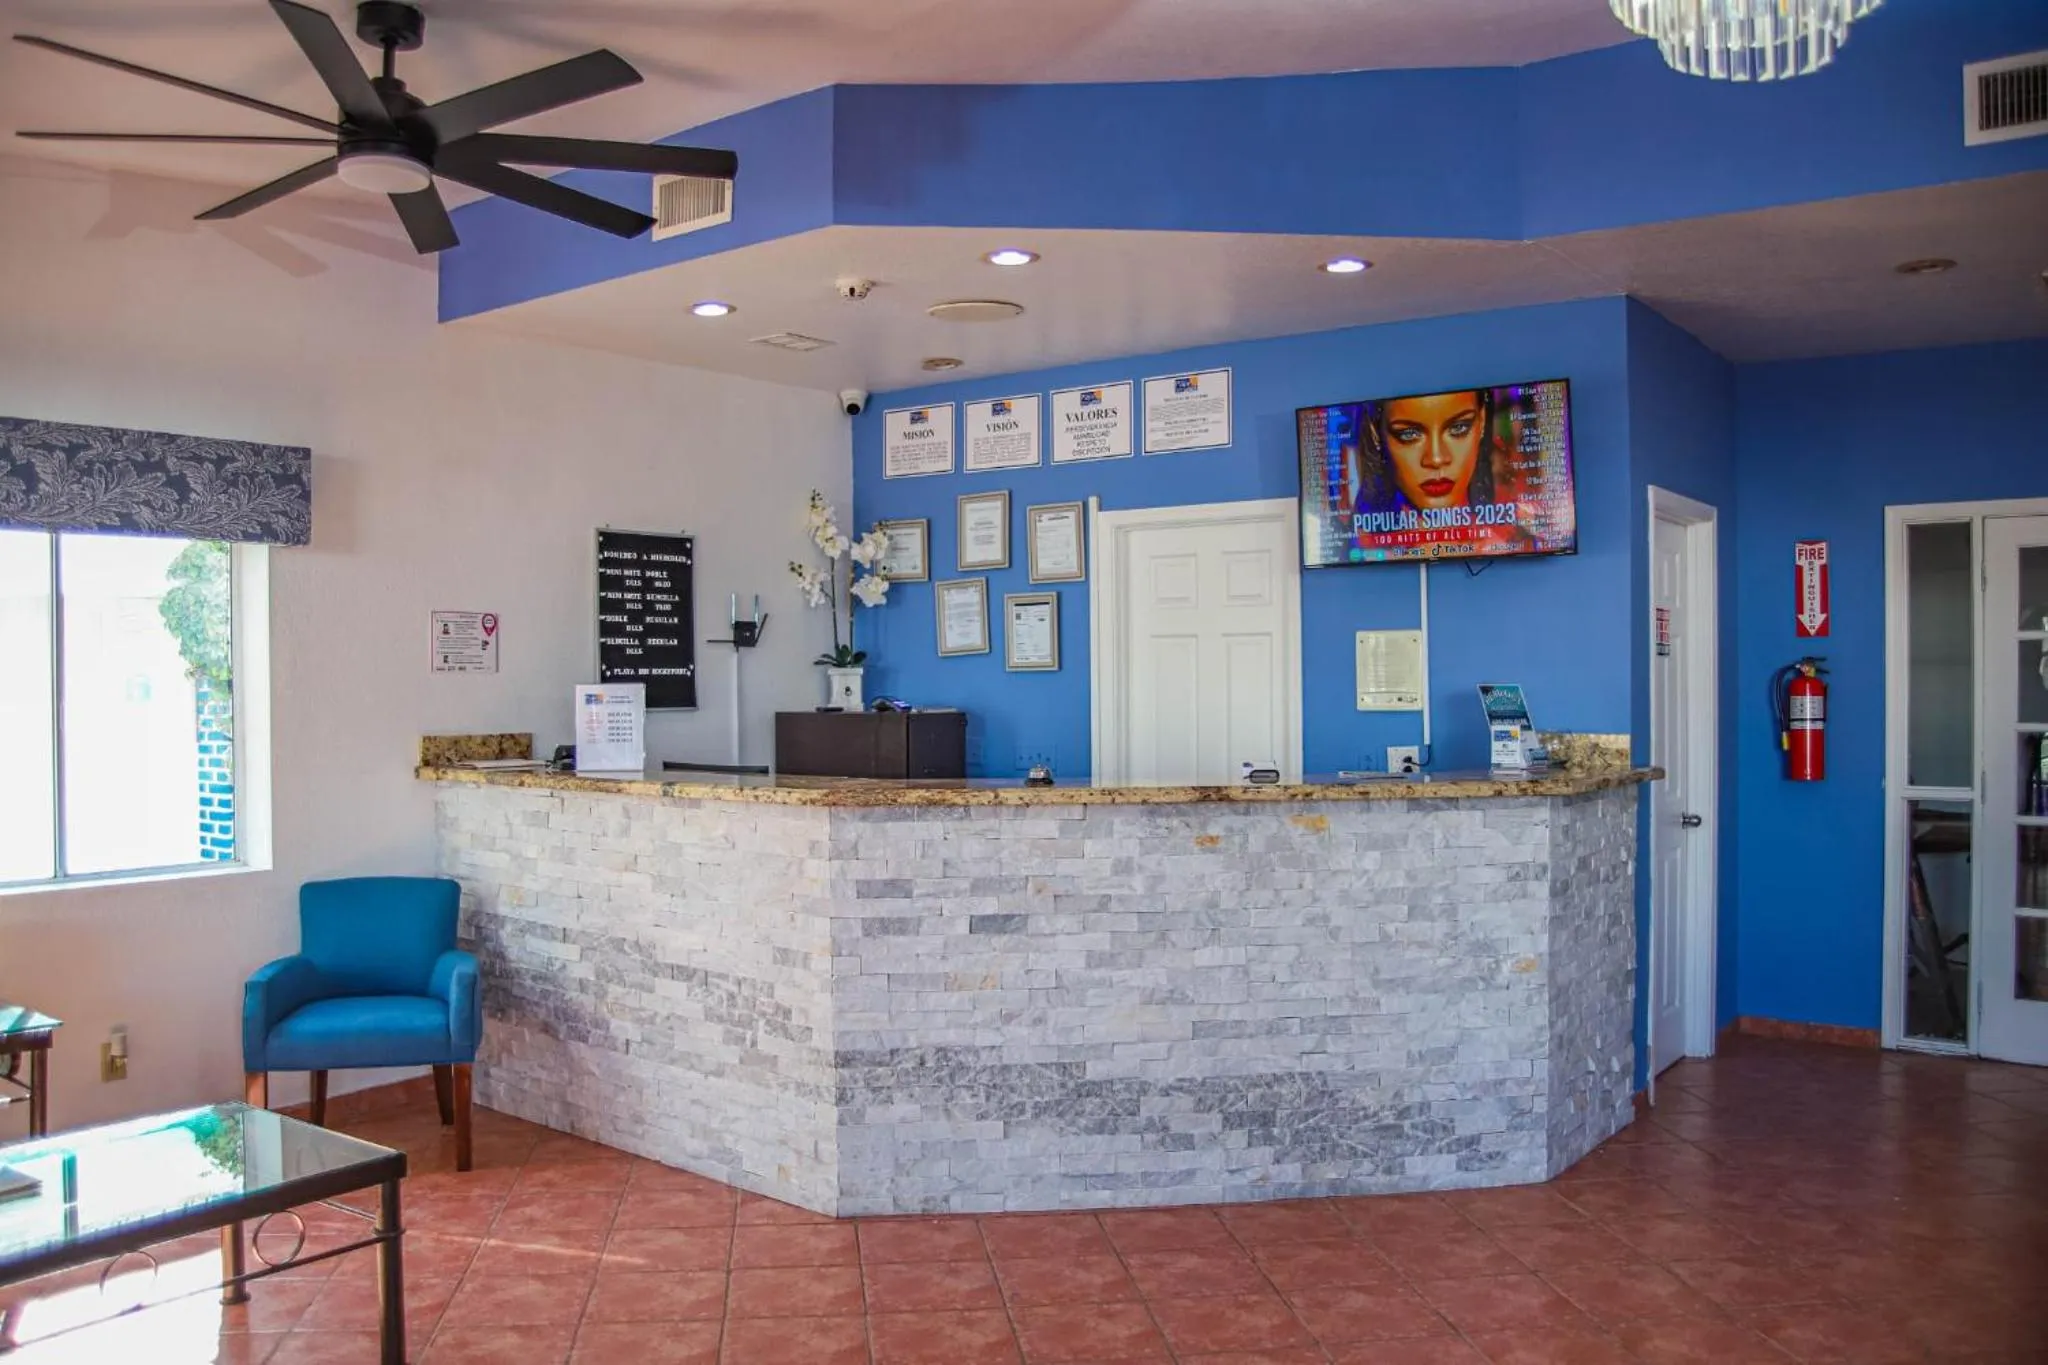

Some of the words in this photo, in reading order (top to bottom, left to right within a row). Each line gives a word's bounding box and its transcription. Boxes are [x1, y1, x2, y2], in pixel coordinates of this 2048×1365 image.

[1065, 407, 1118, 422] VALORES
[986, 419, 1019, 433] VISIÓN
[1353, 510, 1418, 535] POPULAR
[1422, 506, 1472, 528] SONGS
[1475, 503, 1516, 525] 2023
[1374, 535, 1392, 544] 100
[1397, 532, 1420, 543] HITS
[1425, 531, 1436, 541] OF
[1443, 529, 1461, 540] ALL
[1467, 527, 1492, 538] TIME
[1797, 547, 1825, 561] FIRE
[1808, 560, 1816, 630] EXTINGUISHER
